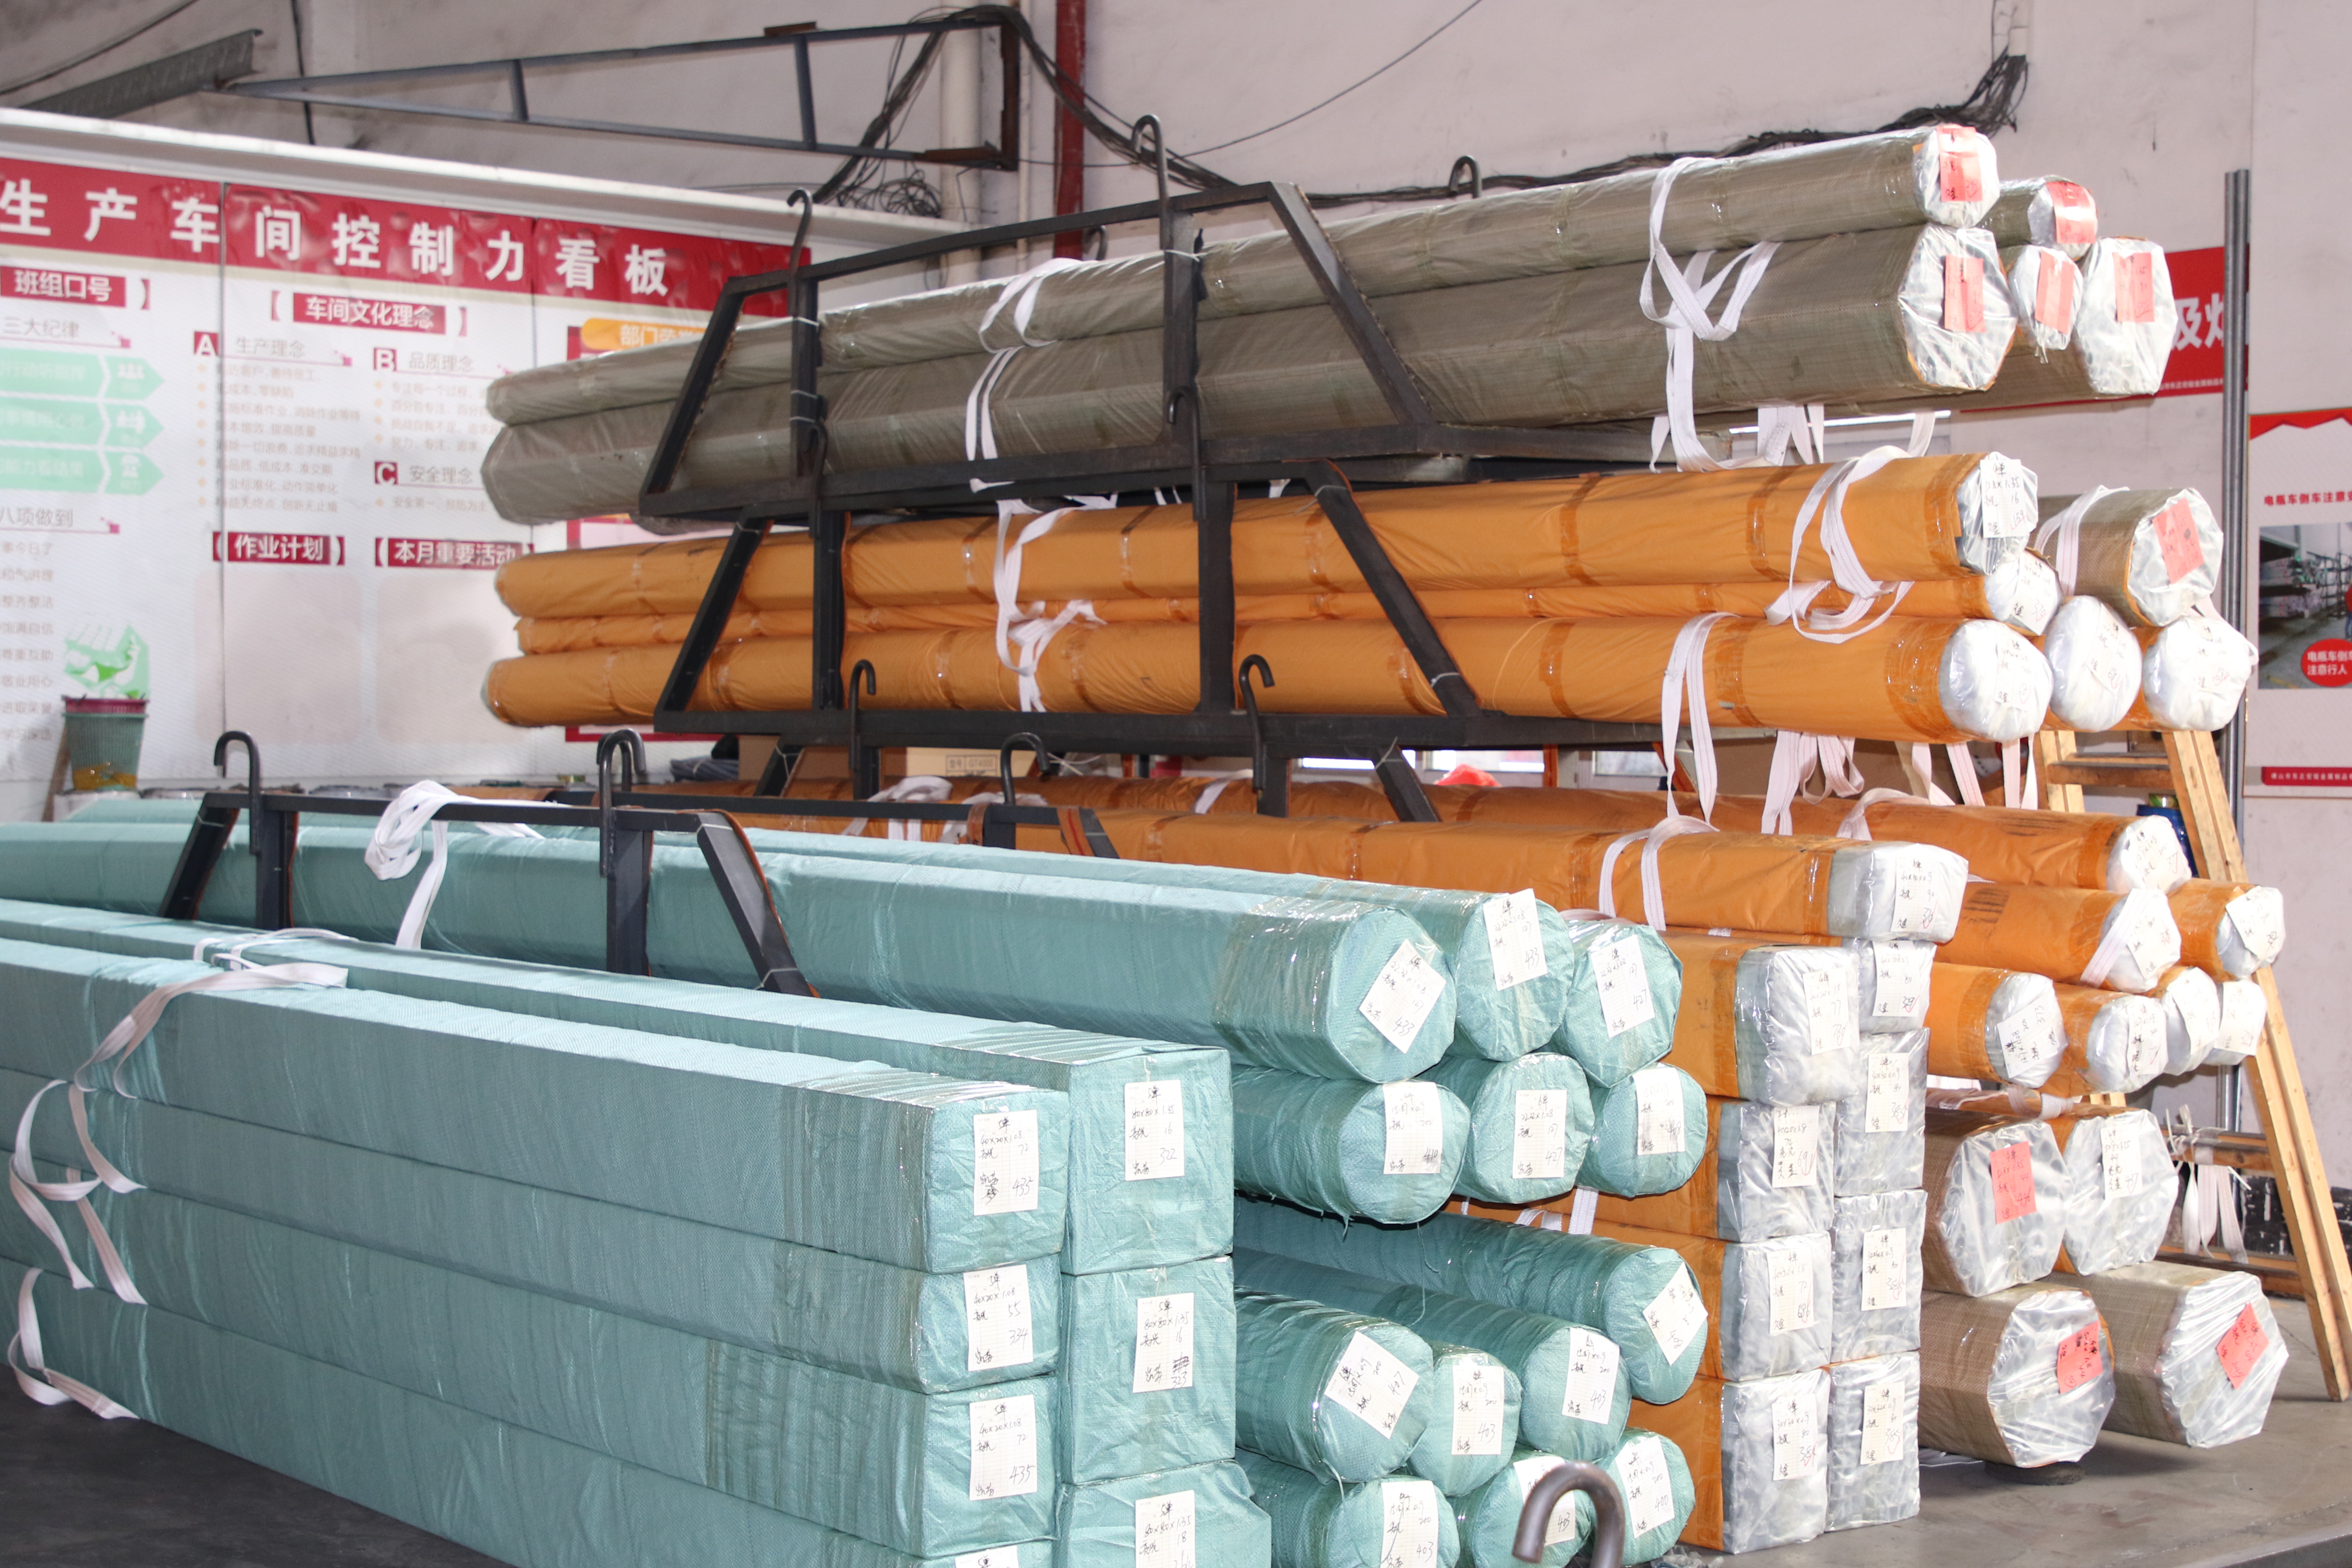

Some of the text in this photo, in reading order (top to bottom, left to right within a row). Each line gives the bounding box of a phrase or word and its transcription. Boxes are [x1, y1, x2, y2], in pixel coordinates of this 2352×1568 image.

[0, 178, 668, 296] 生产车间控制力看板
[14, 270, 113, 302] 班组口号
[306, 296, 435, 330] 车间文化理念
[197, 334, 217, 356] A
[376, 349, 395, 372] B
[377, 462, 472, 485] C 安全理念
[2011, 491, 2019, 504] 16
[235, 536, 325, 561] 作业计划
[395, 540, 516, 567] 本月重要活动
[1525, 947, 1540, 971] 433
[1633, 988, 1647, 1011] 427
[1831, 999, 1841, 1017] 77
[1393, 1016, 1415, 1037] 433
[1164, 1122, 1173, 1135] 16
[1017, 1143, 1029, 1155] 72
[1158, 1147, 1178, 1166] 322
[1423, 1146, 1439, 1162] 410
[1545, 1147, 1563, 1168] 427
[1798, 1280, 1807, 1294] 72
[1008, 1300, 1021, 1318] 55
[1009, 1327, 1029, 1351] 334
[1176, 1326, 1182, 1343] 16
[1170, 1371, 1188, 1388] 323
[1590, 1389, 1607, 1410] 403
[1017, 1433, 1029, 1446] 72
[1477, 1422, 1496, 1444] 403
[1801, 1429, 1810, 1438] 80
[1009, 1464, 1036, 1485] 435
[1654, 1494, 1669, 1512] 400
[1557, 1512, 1570, 1533] 403
[1177, 1531, 1187, 1546] 18
[1416, 1540, 1434, 1564] 403
